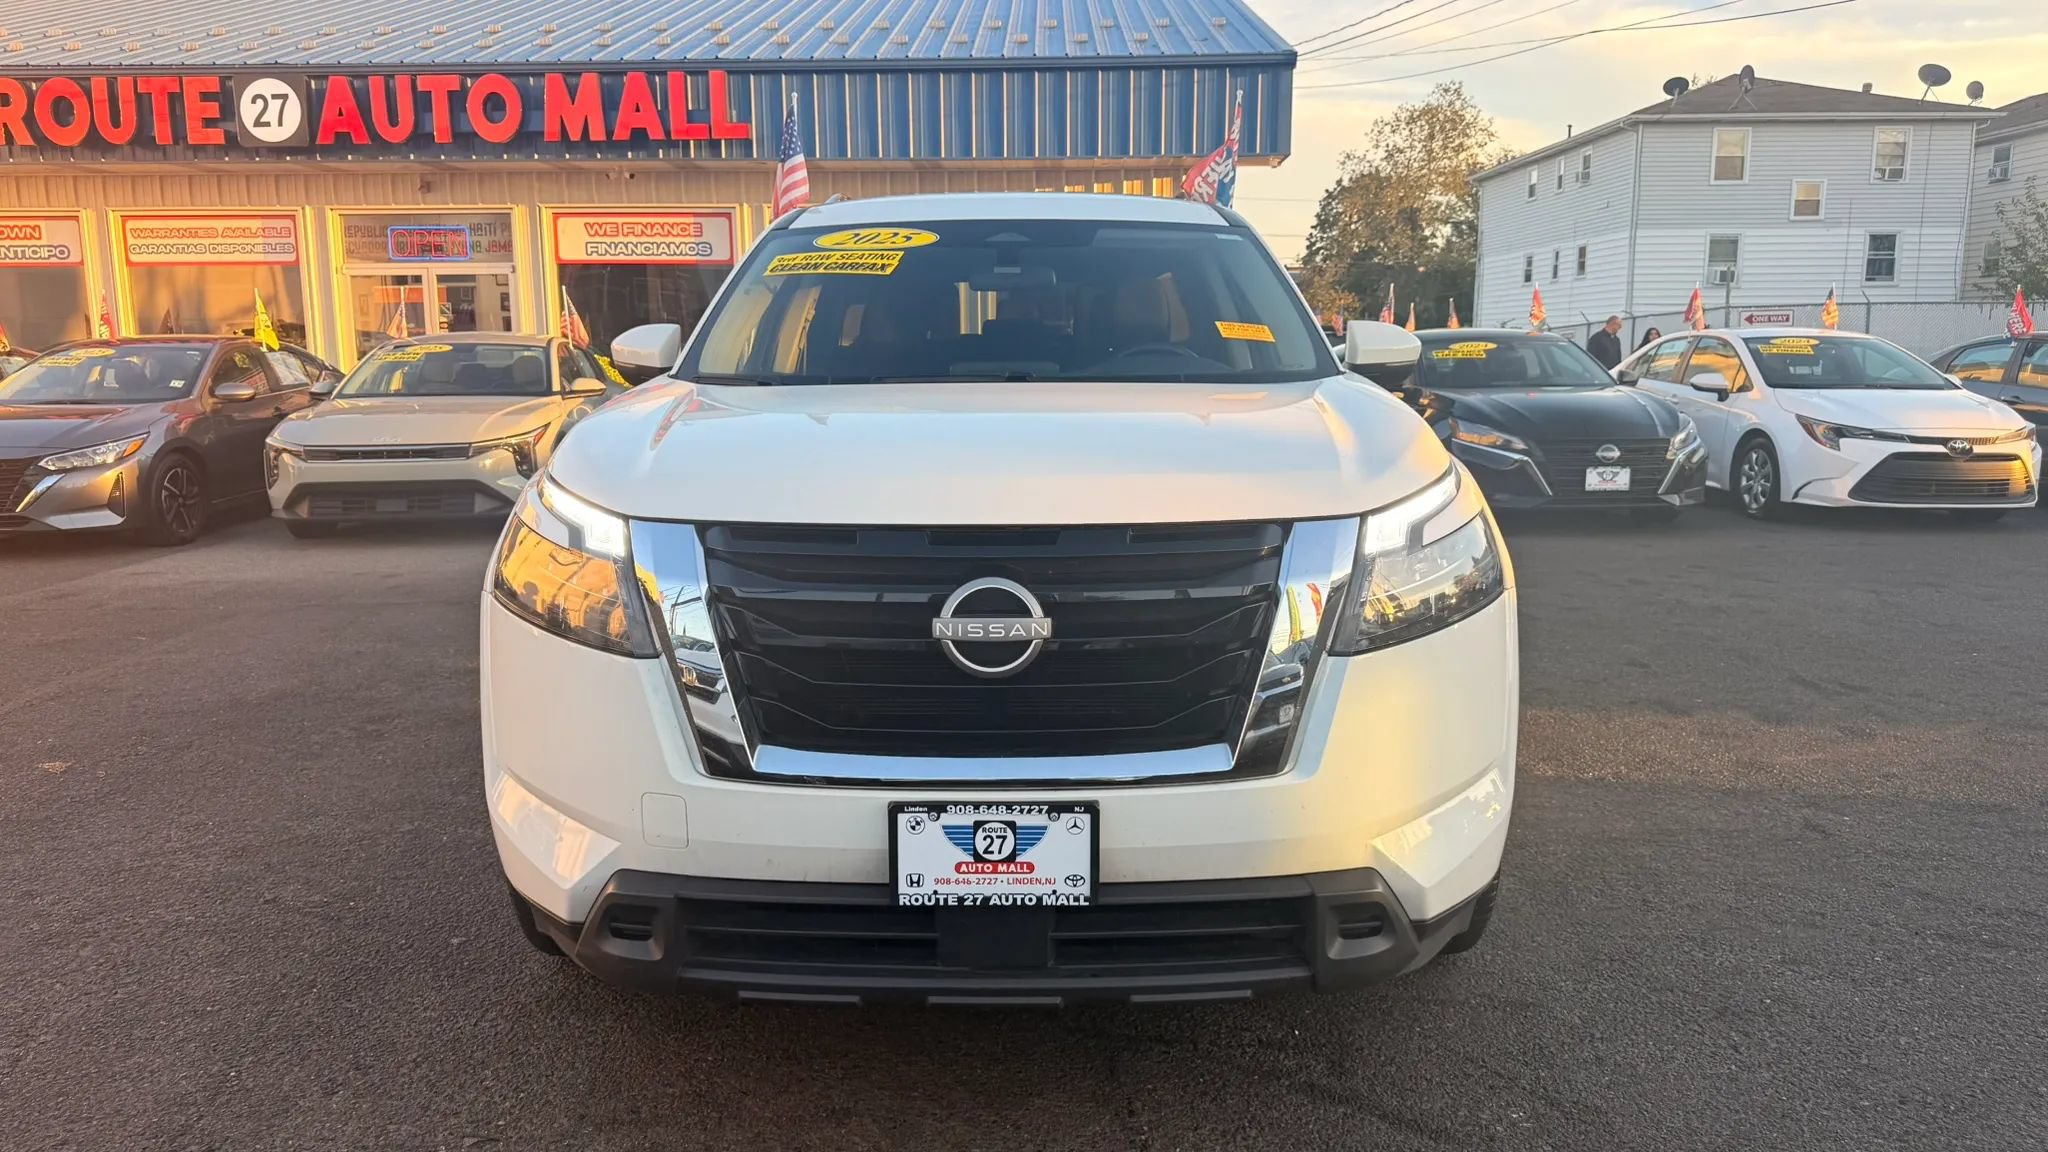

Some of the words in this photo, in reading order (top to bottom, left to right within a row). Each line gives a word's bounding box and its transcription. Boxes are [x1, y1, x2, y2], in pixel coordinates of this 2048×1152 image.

[0, 76, 226, 146] ROUTE
[250, 93, 289, 128] 27
[316, 74, 523, 145] AUTO
[544, 70, 751, 141] MALL
[130, 227, 218, 239] WARRANTIES
[221, 226, 292, 239] AVAILABLE
[584, 222, 619, 237] WE
[622, 222, 703, 238] FINANCE
[391, 230, 468, 258] OPEN
[832, 231, 921, 246] 2025
[0, 245, 70, 260] NTICIPO
[129, 243, 206, 255] GARANTIAS
[209, 243, 295, 255] DISPONIBLES
[586, 241, 713, 257] FINANCIAMOS
[800, 253, 835, 262] ROW
[838, 252, 899, 261] SEATING
[769, 262, 824, 273] CLEAN
[824, 261, 893, 273] CARFAX
[1752, 315, 1769, 323] ONE
[1770, 314, 1788, 322] WAY
[936, 623, 1048, 637] NISSAN
[946, 805, 1048, 815] 908-648-2727
[982, 835, 1008, 855] 27
[960, 863, 993, 873] AUTO
[998, 863, 1030, 873] MALL
[899, 893, 959, 906] ROUTE
[964, 893, 983, 906] 27
[989, 893, 1036, 906] AUTO
[1042, 893, 1089, 906] MALL
